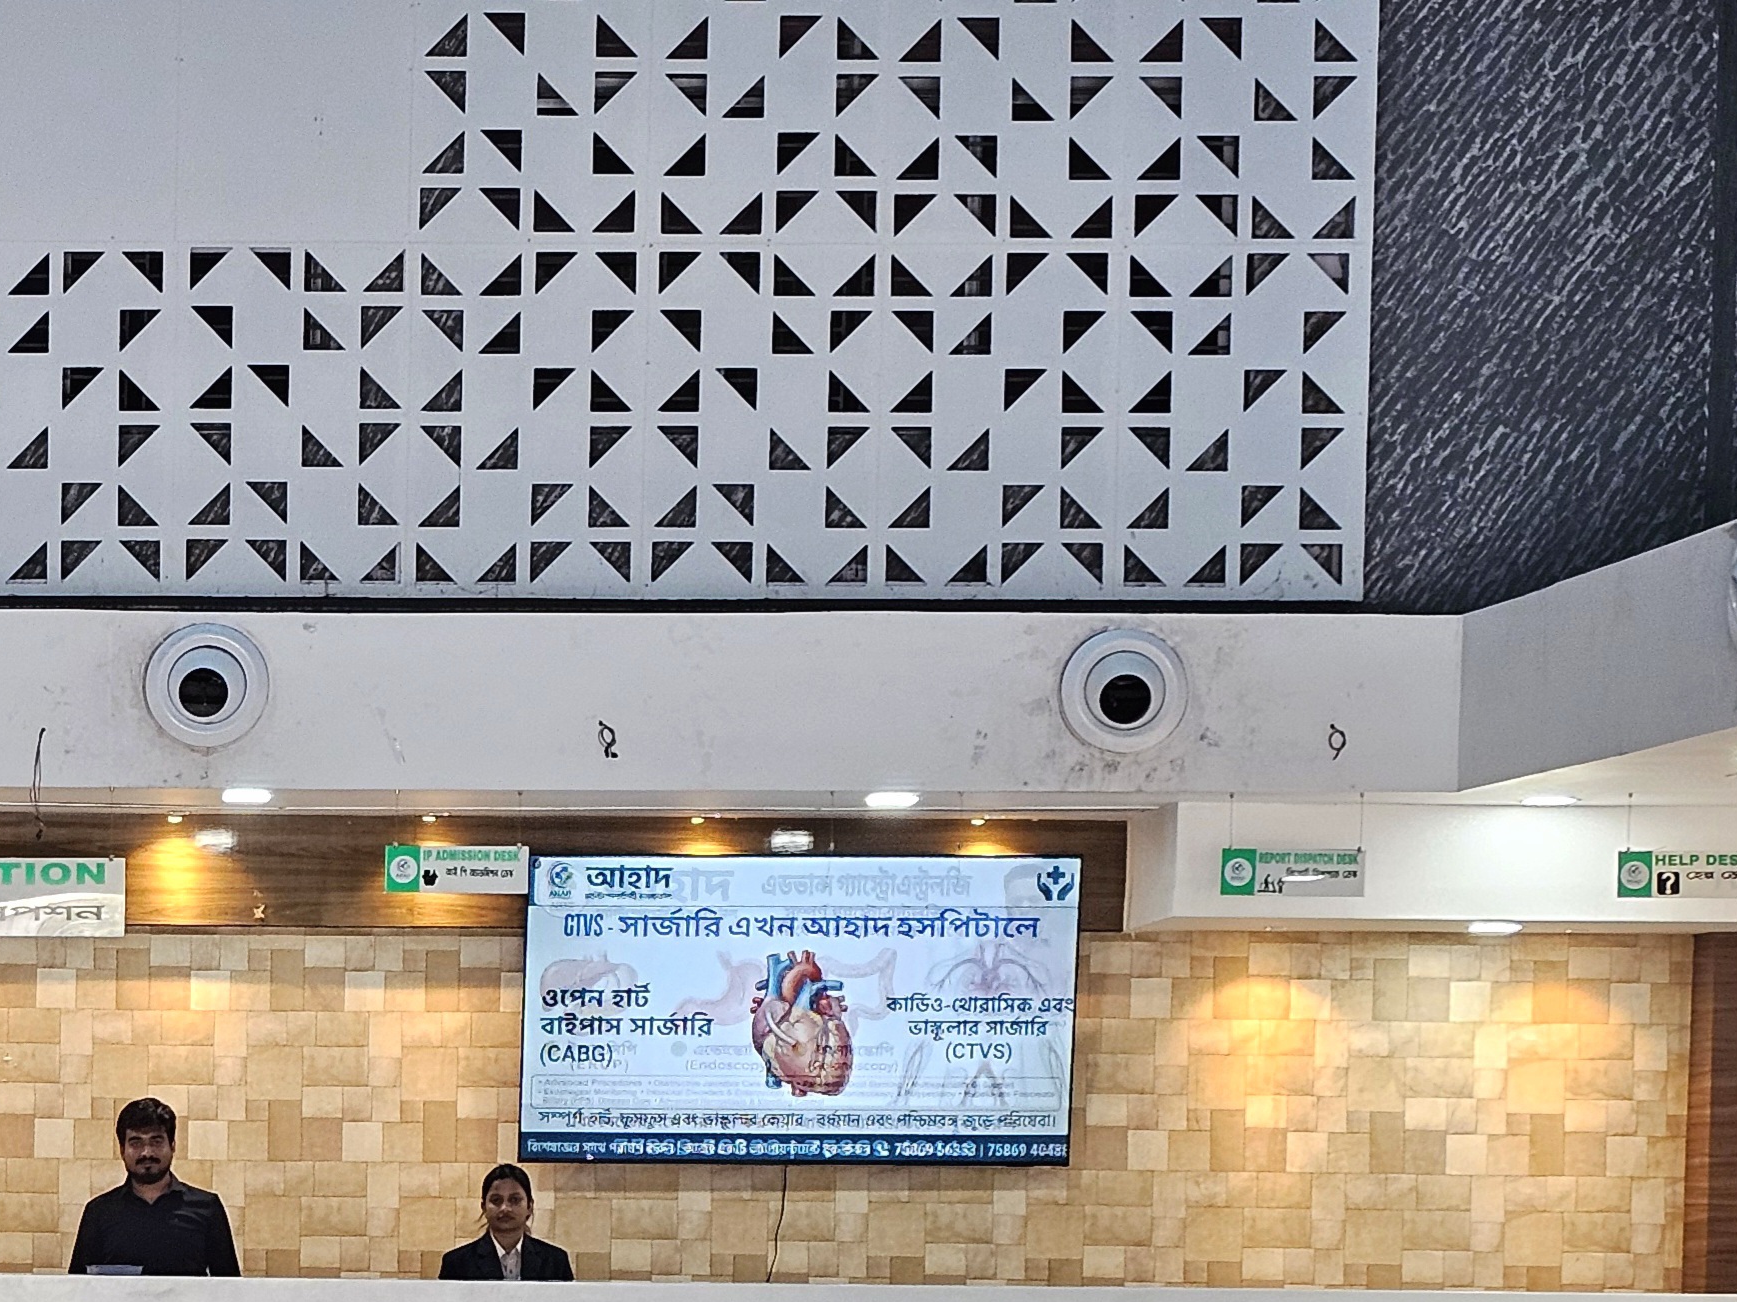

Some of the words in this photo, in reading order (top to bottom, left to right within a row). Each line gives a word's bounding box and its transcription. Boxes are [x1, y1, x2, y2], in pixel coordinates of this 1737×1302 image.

[423, 850, 433, 862] IP
[436, 850, 491, 862] ADMISSION
[493, 850, 521, 863] DESK
[1258, 852, 1292, 864] REPORT
[1294, 853, 1335, 865] DISPATCH
[1336, 853, 1360, 865] DESK
[1654, 854, 1700, 866] HELP
[1705, 855, 1737, 866] DES
[585, 865, 674, 889] আহাদ
[564, 913, 604, 937] CTVS
[618, 907, 724, 938] সার্জারি
[729, 915, 797, 938] এখন
[802, 915, 893, 940] আহাদ
[897, 909, 1041, 939] হসপিটালে
[542, 988, 606, 1008] ওপেন
[612, 983, 651, 1008] হার্ট
[1038, 996, 1075, 1014] এবং
[540, 1012, 623, 1036] বাইপাস
[630, 1012, 715, 1037] সার্জারি
[986, 1016, 1050, 1037] সার্জারি
[540, 1042, 613, 1067] (CABG)
[945, 1042, 1013, 1063] (CTVS)
[987, 1143, 1027, 1157] 75869
